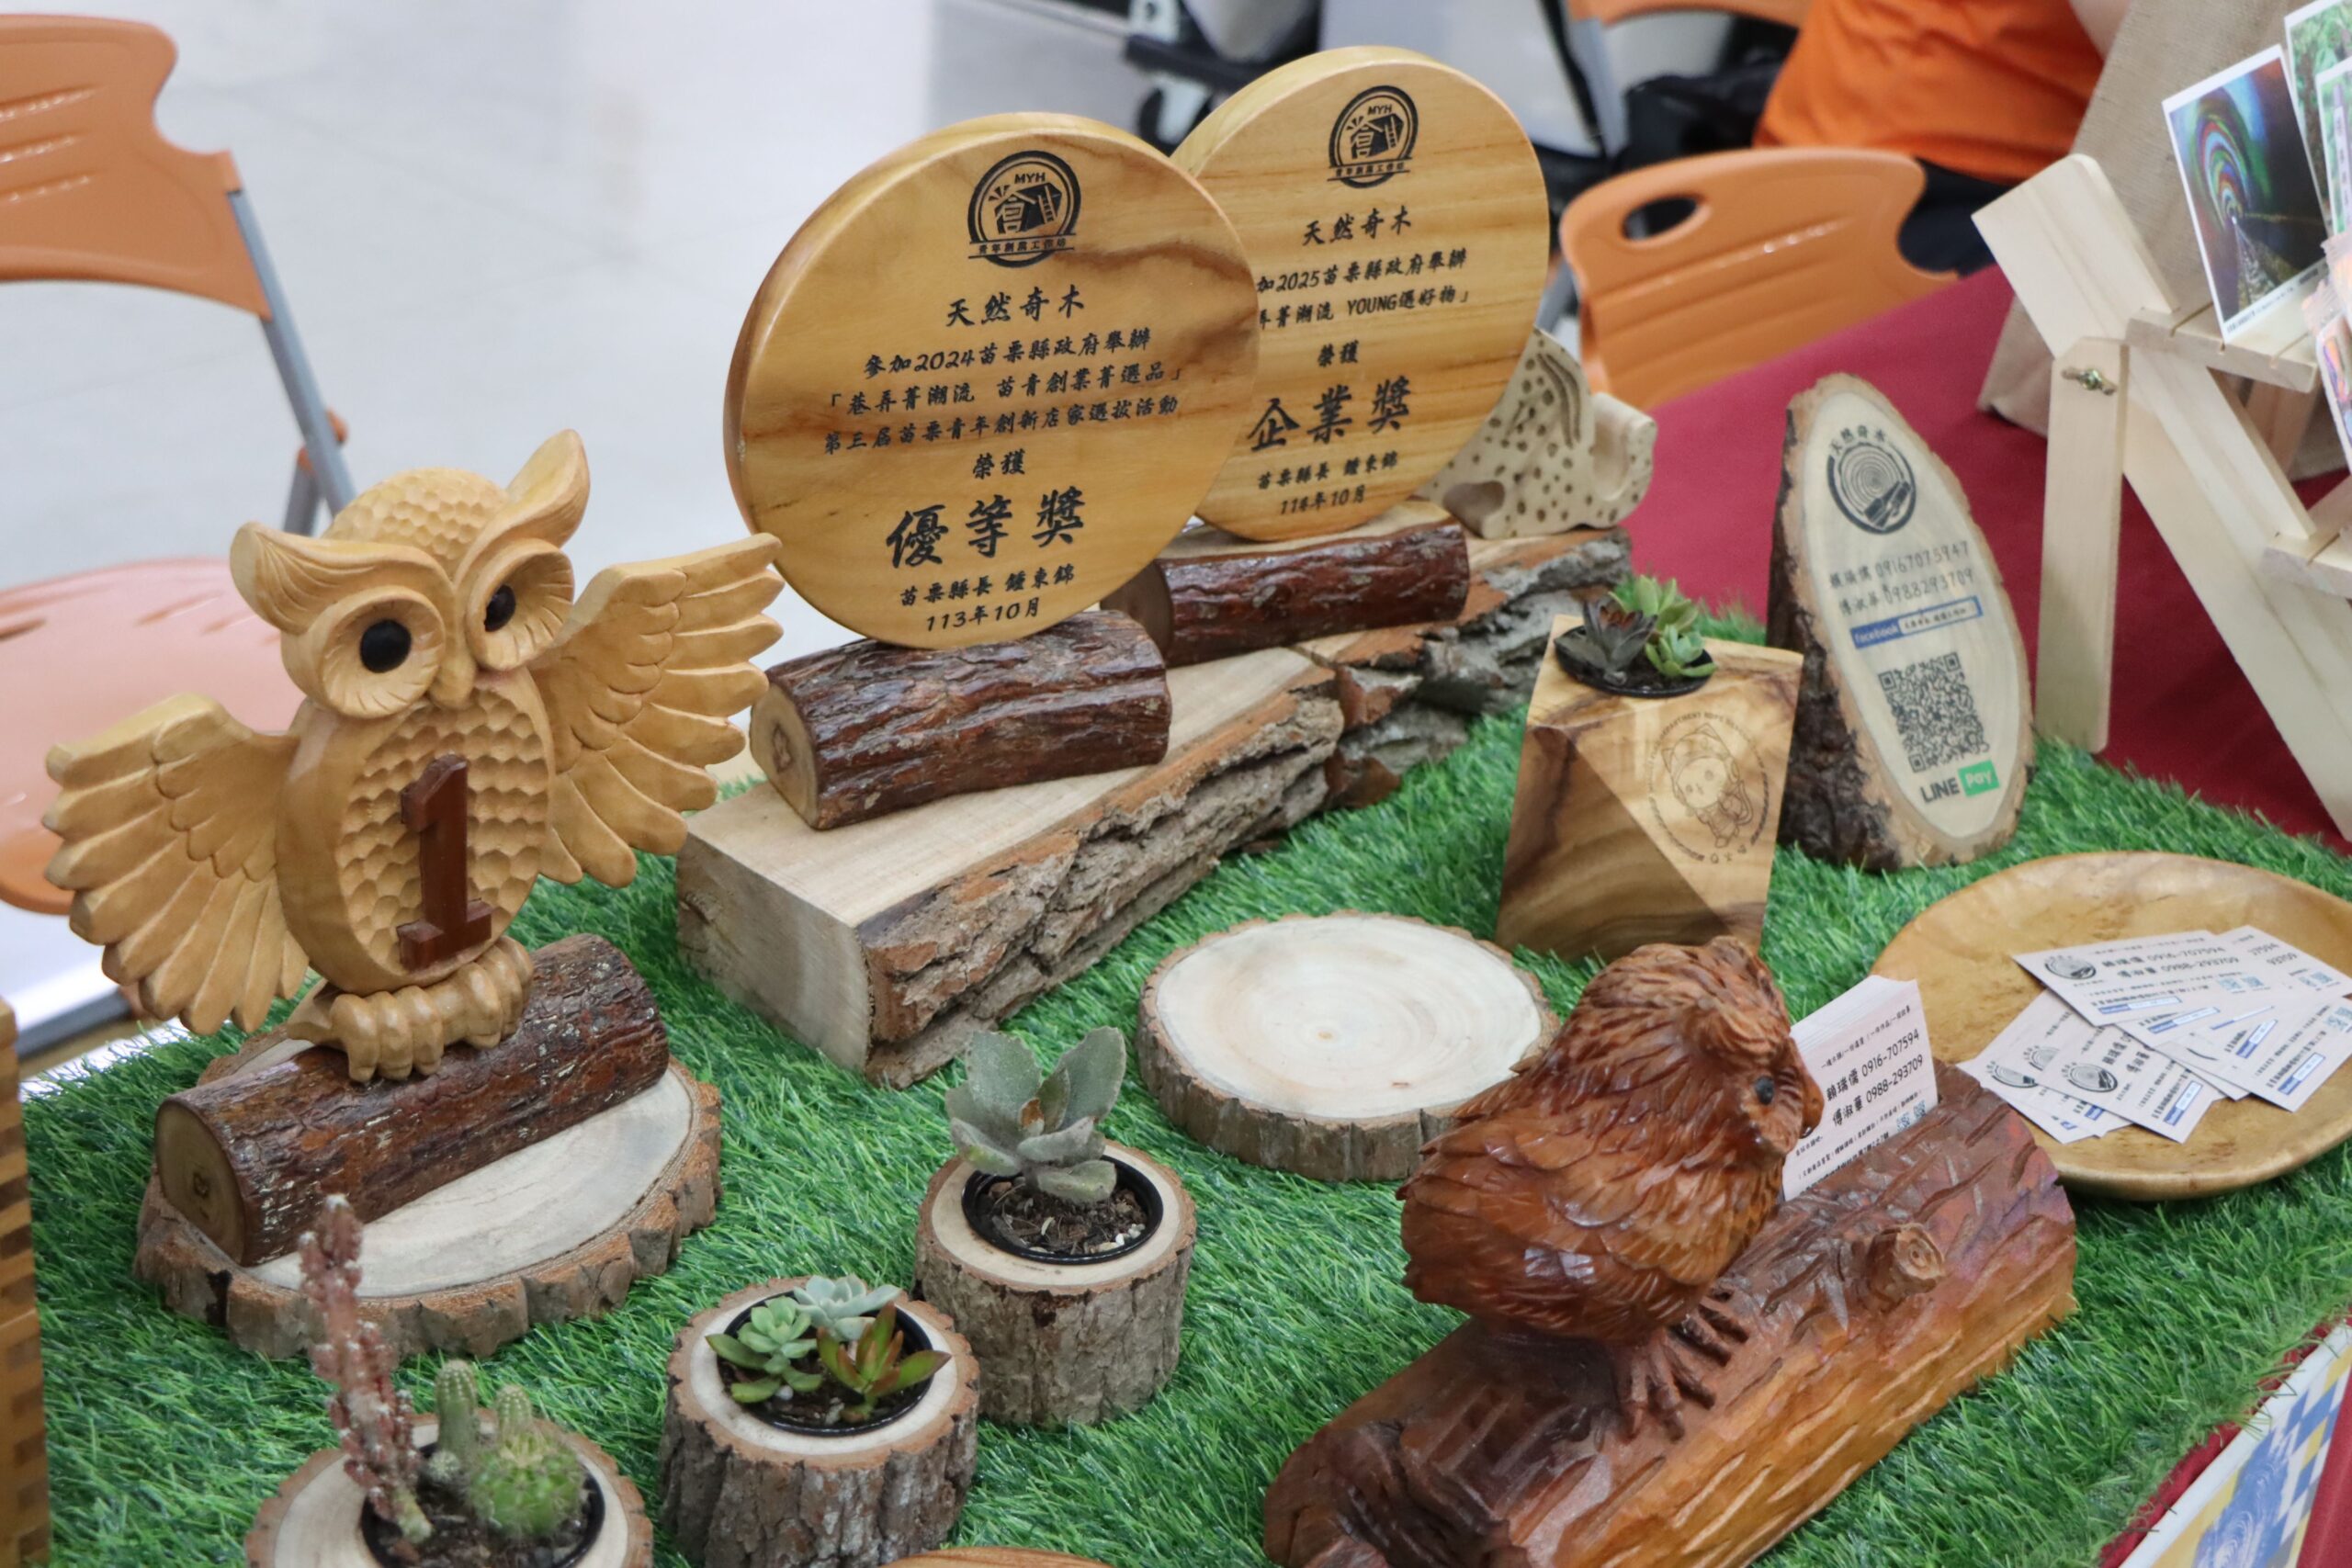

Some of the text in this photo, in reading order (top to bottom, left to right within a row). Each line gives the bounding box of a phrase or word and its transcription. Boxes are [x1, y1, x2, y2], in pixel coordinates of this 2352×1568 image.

[1367, 104, 1392, 115] MYH
[1014, 173, 1046, 184] MYH
[1302, 205, 1412, 246] 天然奇木
[945, 284, 1085, 327] 天然奇木
[864, 327, 1152, 379] 參加2024苗栗縣政府舉辦
[1317, 339, 1359, 367] 榮獲
[1247, 375, 1411, 452] 企業獎
[972, 448, 1025, 479] 榮獲
[1258, 461, 1329, 490] 苗栗縣長
[886, 486, 1086, 568] 優等獎
[899, 576, 993, 606] 苗栗縣長
[926, 597, 1040, 631] 113年10月
[1854, 624, 1899, 644] facebook
[1920, 776, 1961, 804] LINE
[398, 752, 492, 974] 1
[1826, 1067, 1860, 1102] 賴瑞儒
[1861, 1028, 1920, 1078] 0916-707594
[1832, 1095, 1864, 1128] 傅淑華
[1865, 1054, 1924, 1104] 0988-293709
